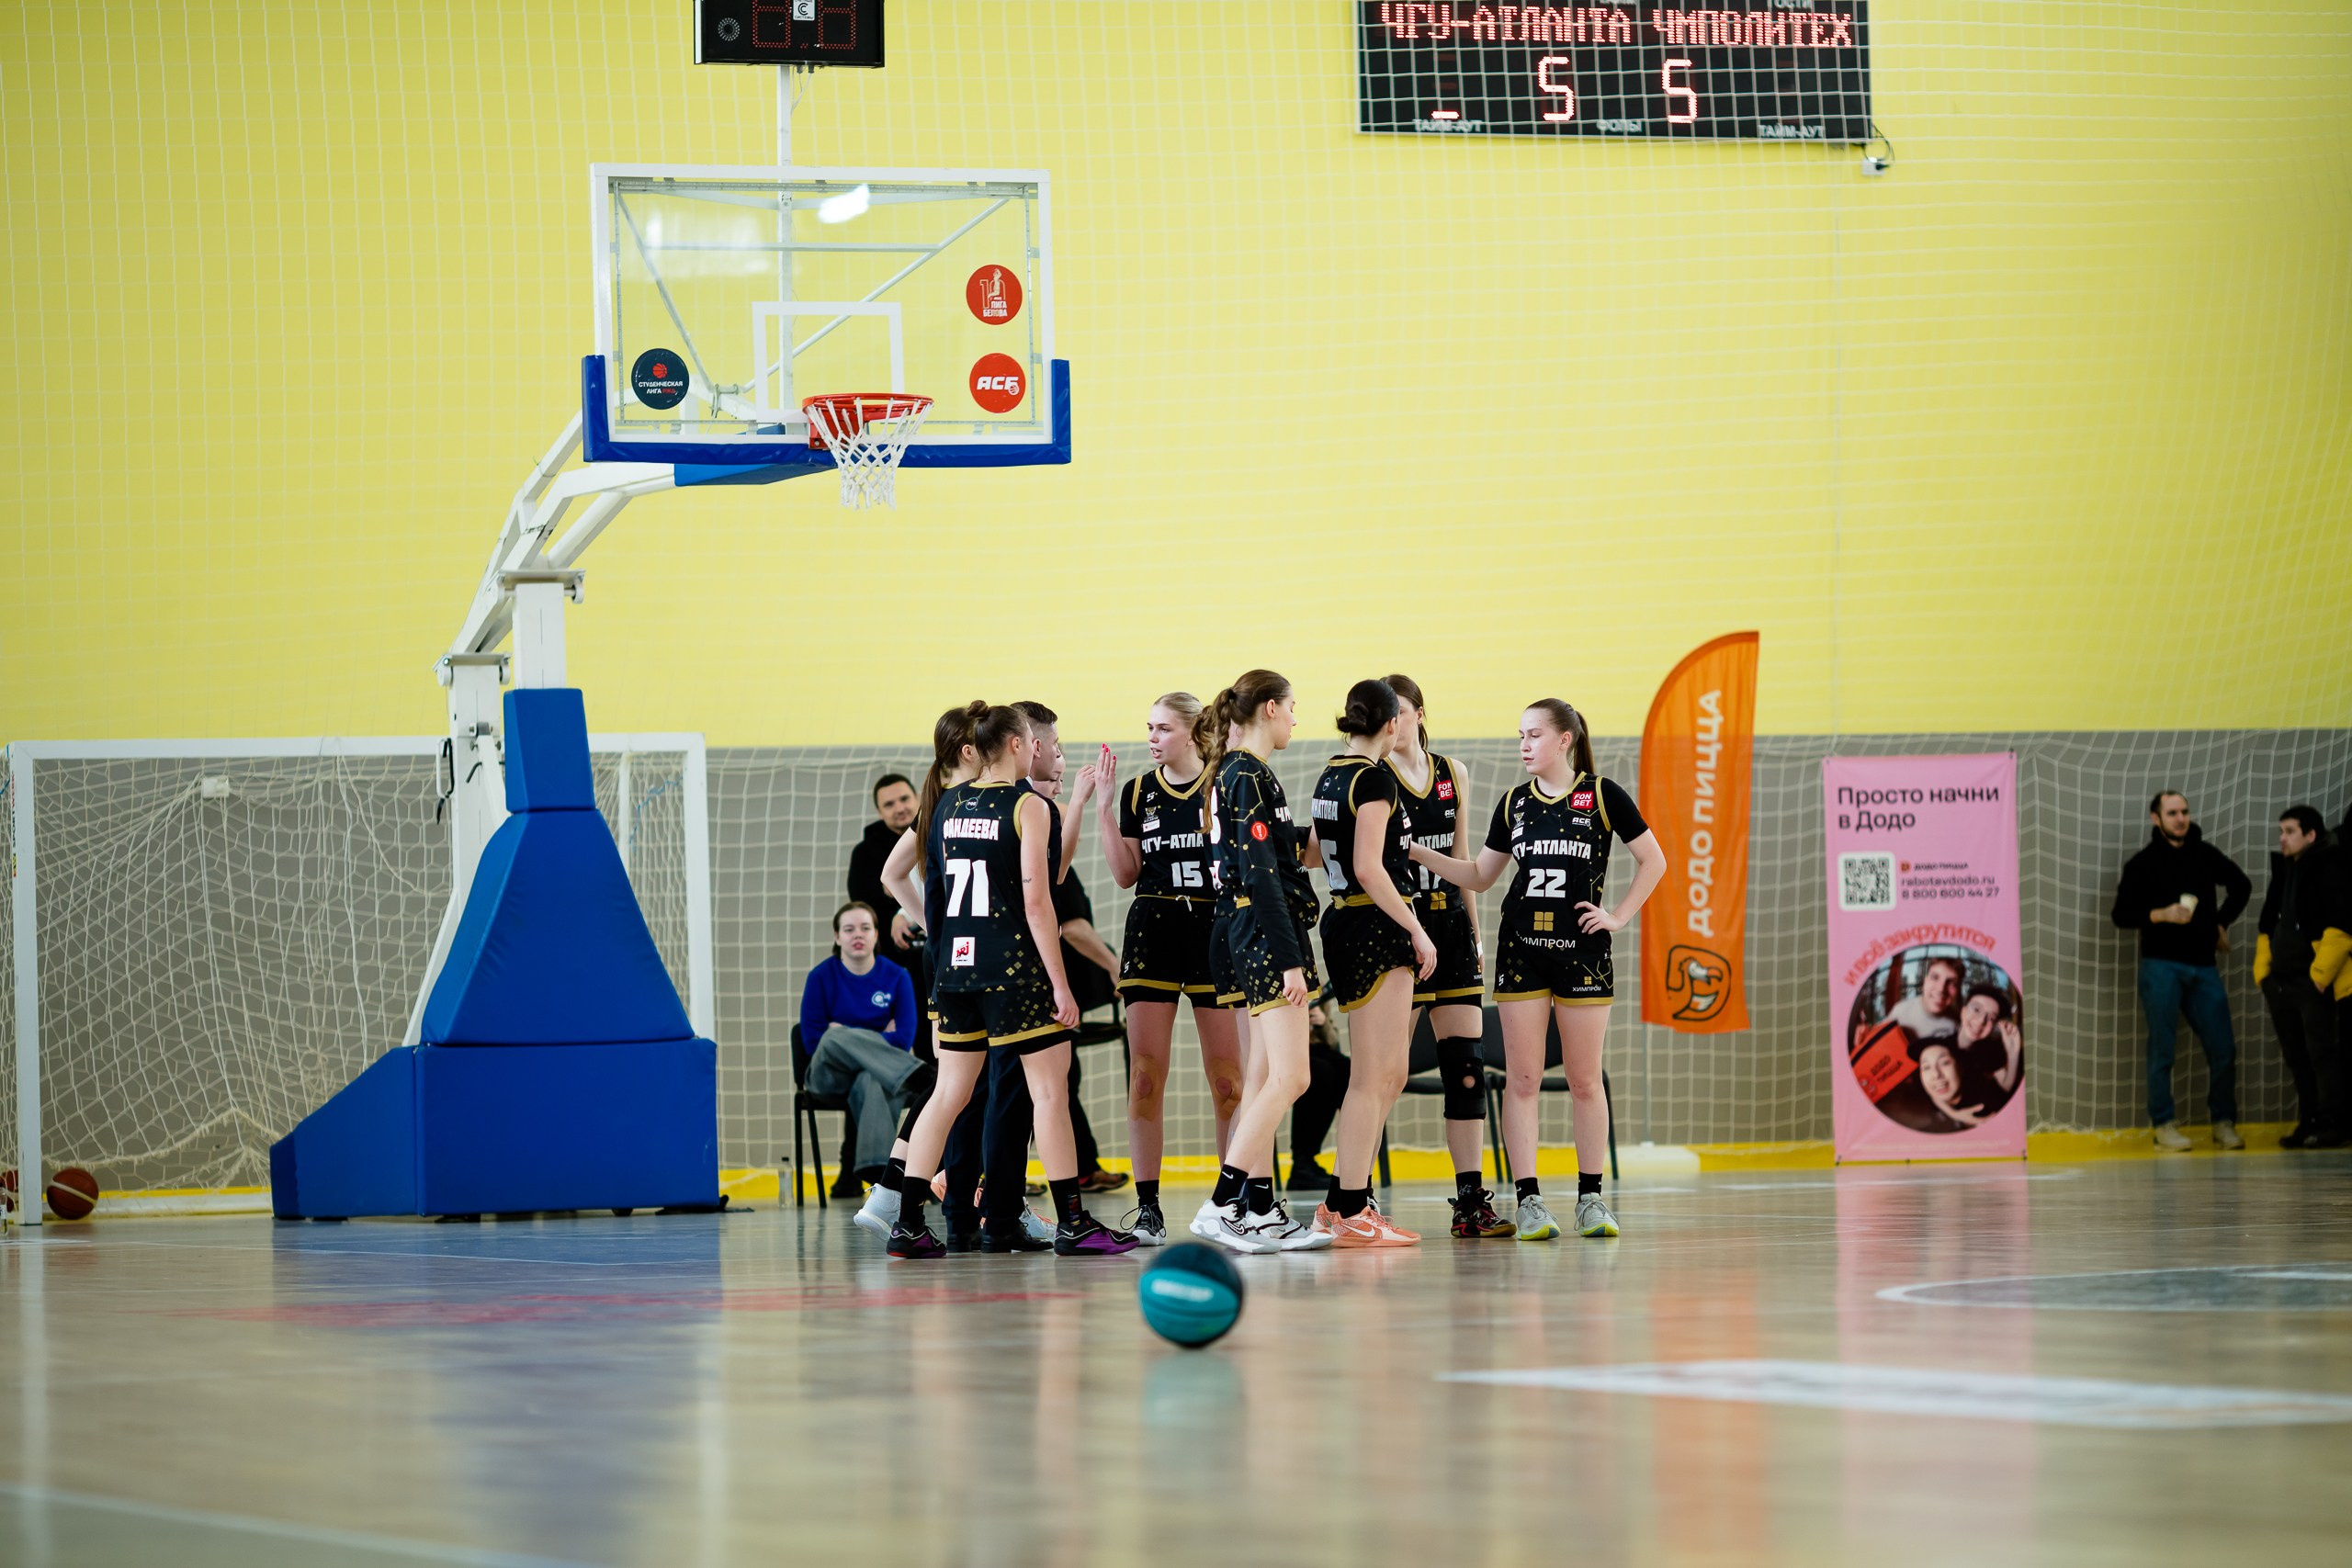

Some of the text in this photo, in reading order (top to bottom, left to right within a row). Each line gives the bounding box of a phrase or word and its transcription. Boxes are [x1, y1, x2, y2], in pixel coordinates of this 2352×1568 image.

[1381, 3, 1852, 48] ЧГУ-АТЛАНТА ЧМПОЛИТЕХ
[1537, 56, 1575, 121] 5
[1661, 59, 1698, 123] 5
[1758, 123, 1824, 138] ТАЙМ-АУТ
[977, 376, 1020, 396] АСБ
[1838, 787, 2000, 808] Просто начни
[1687, 690, 1724, 938] ДОДО ПИЦЦА
[1839, 810, 1917, 832] в Додо
[1141, 832, 1204, 853] ЧГУ-АТЛА
[1170, 861, 1204, 887] 15
[1525, 868, 1566, 898] 22
[945, 859, 989, 917] 71
[1516, 931, 1577, 949] ИМПРОМ
[1884, 923, 1996, 952] закрутится
